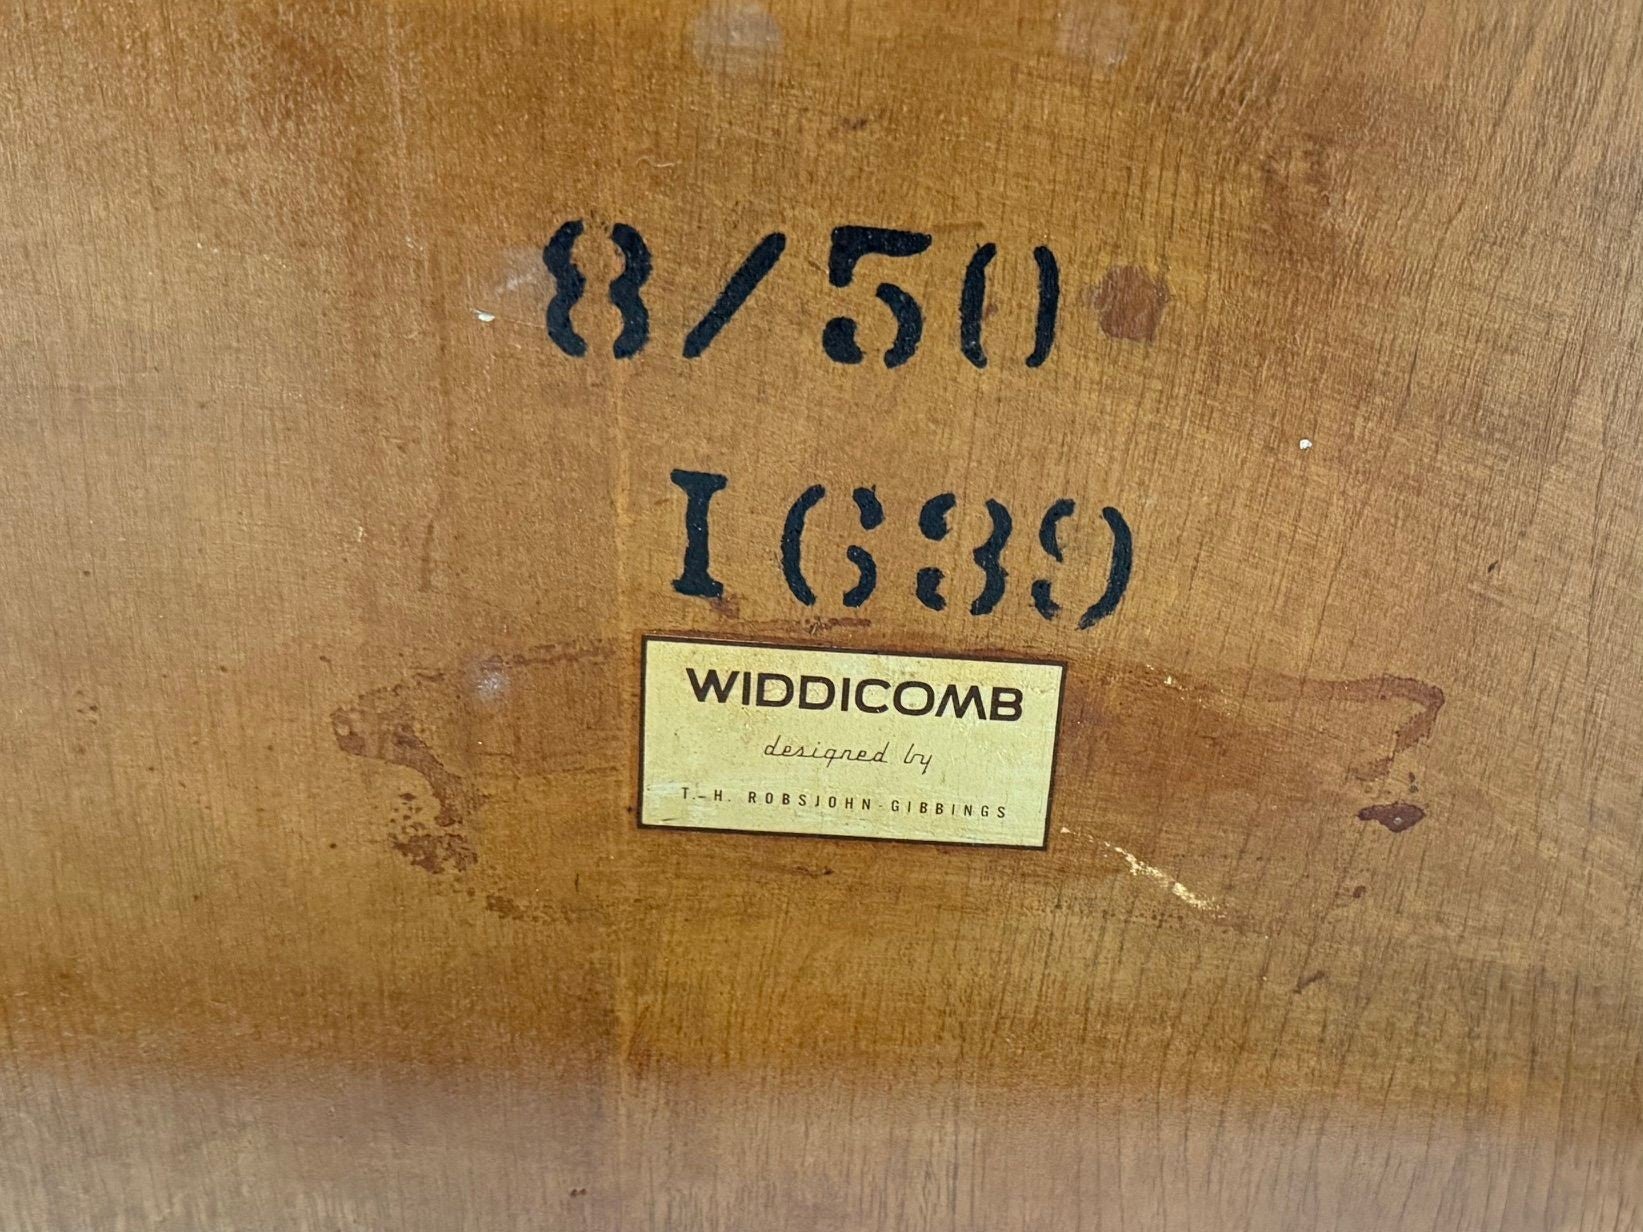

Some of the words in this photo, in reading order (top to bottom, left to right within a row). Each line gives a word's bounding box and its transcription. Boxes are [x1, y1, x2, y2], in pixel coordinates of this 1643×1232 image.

[543, 219, 1060, 370] 8/50
[685, 667, 1024, 722] WIDDICOMB
[763, 734, 890, 769] designed
[903, 743, 933, 776] by
[748, 790, 1007, 819] ROBSJOHN-GIBBINGS
